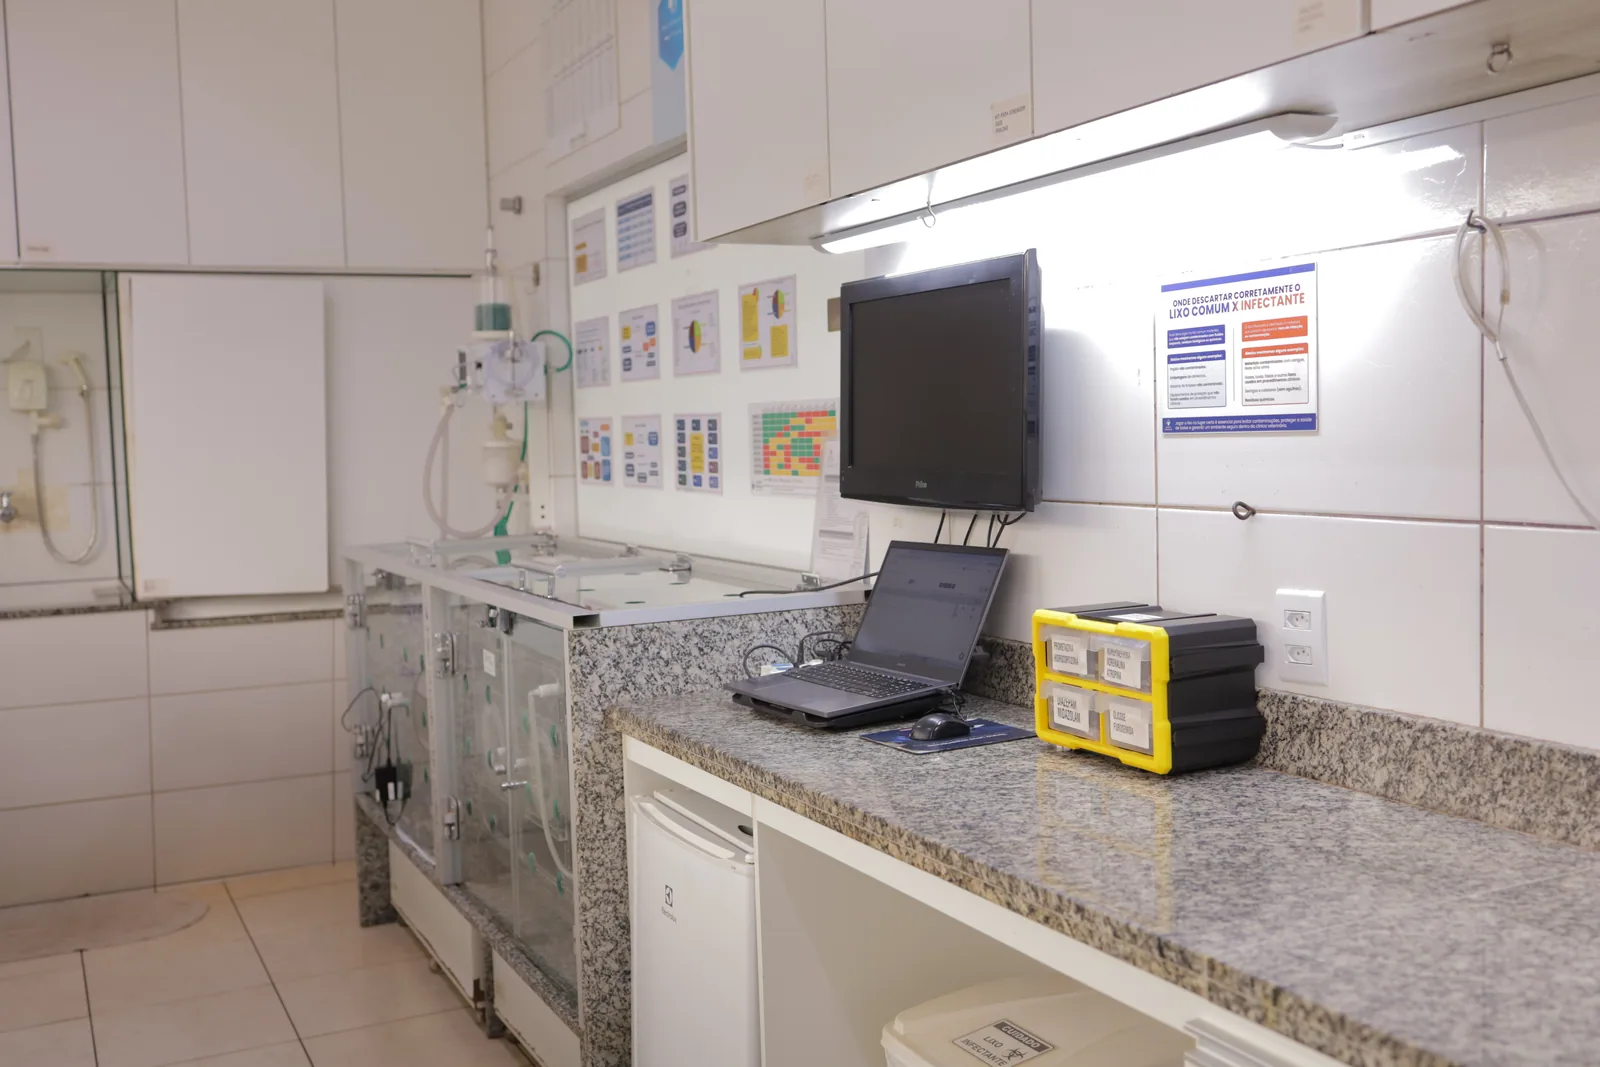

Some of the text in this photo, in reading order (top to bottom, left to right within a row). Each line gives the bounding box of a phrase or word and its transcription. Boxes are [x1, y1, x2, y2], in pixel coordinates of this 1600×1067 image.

[1169, 292, 1305, 319] LIXO COMUM X INFECTANTE
[1173, 298, 1191, 307] ONDE
[1192, 292, 1232, 305] DESCARTAR
[1234, 285, 1293, 300] CORRETAMENTE
[1057, 707, 1081, 723] MIDAZOLAM
[983, 1036, 1003, 1048] LIXO
[1001, 1025, 1040, 1048] CUIDADO
[960, 1038, 1008, 1066] INFECTANTE
